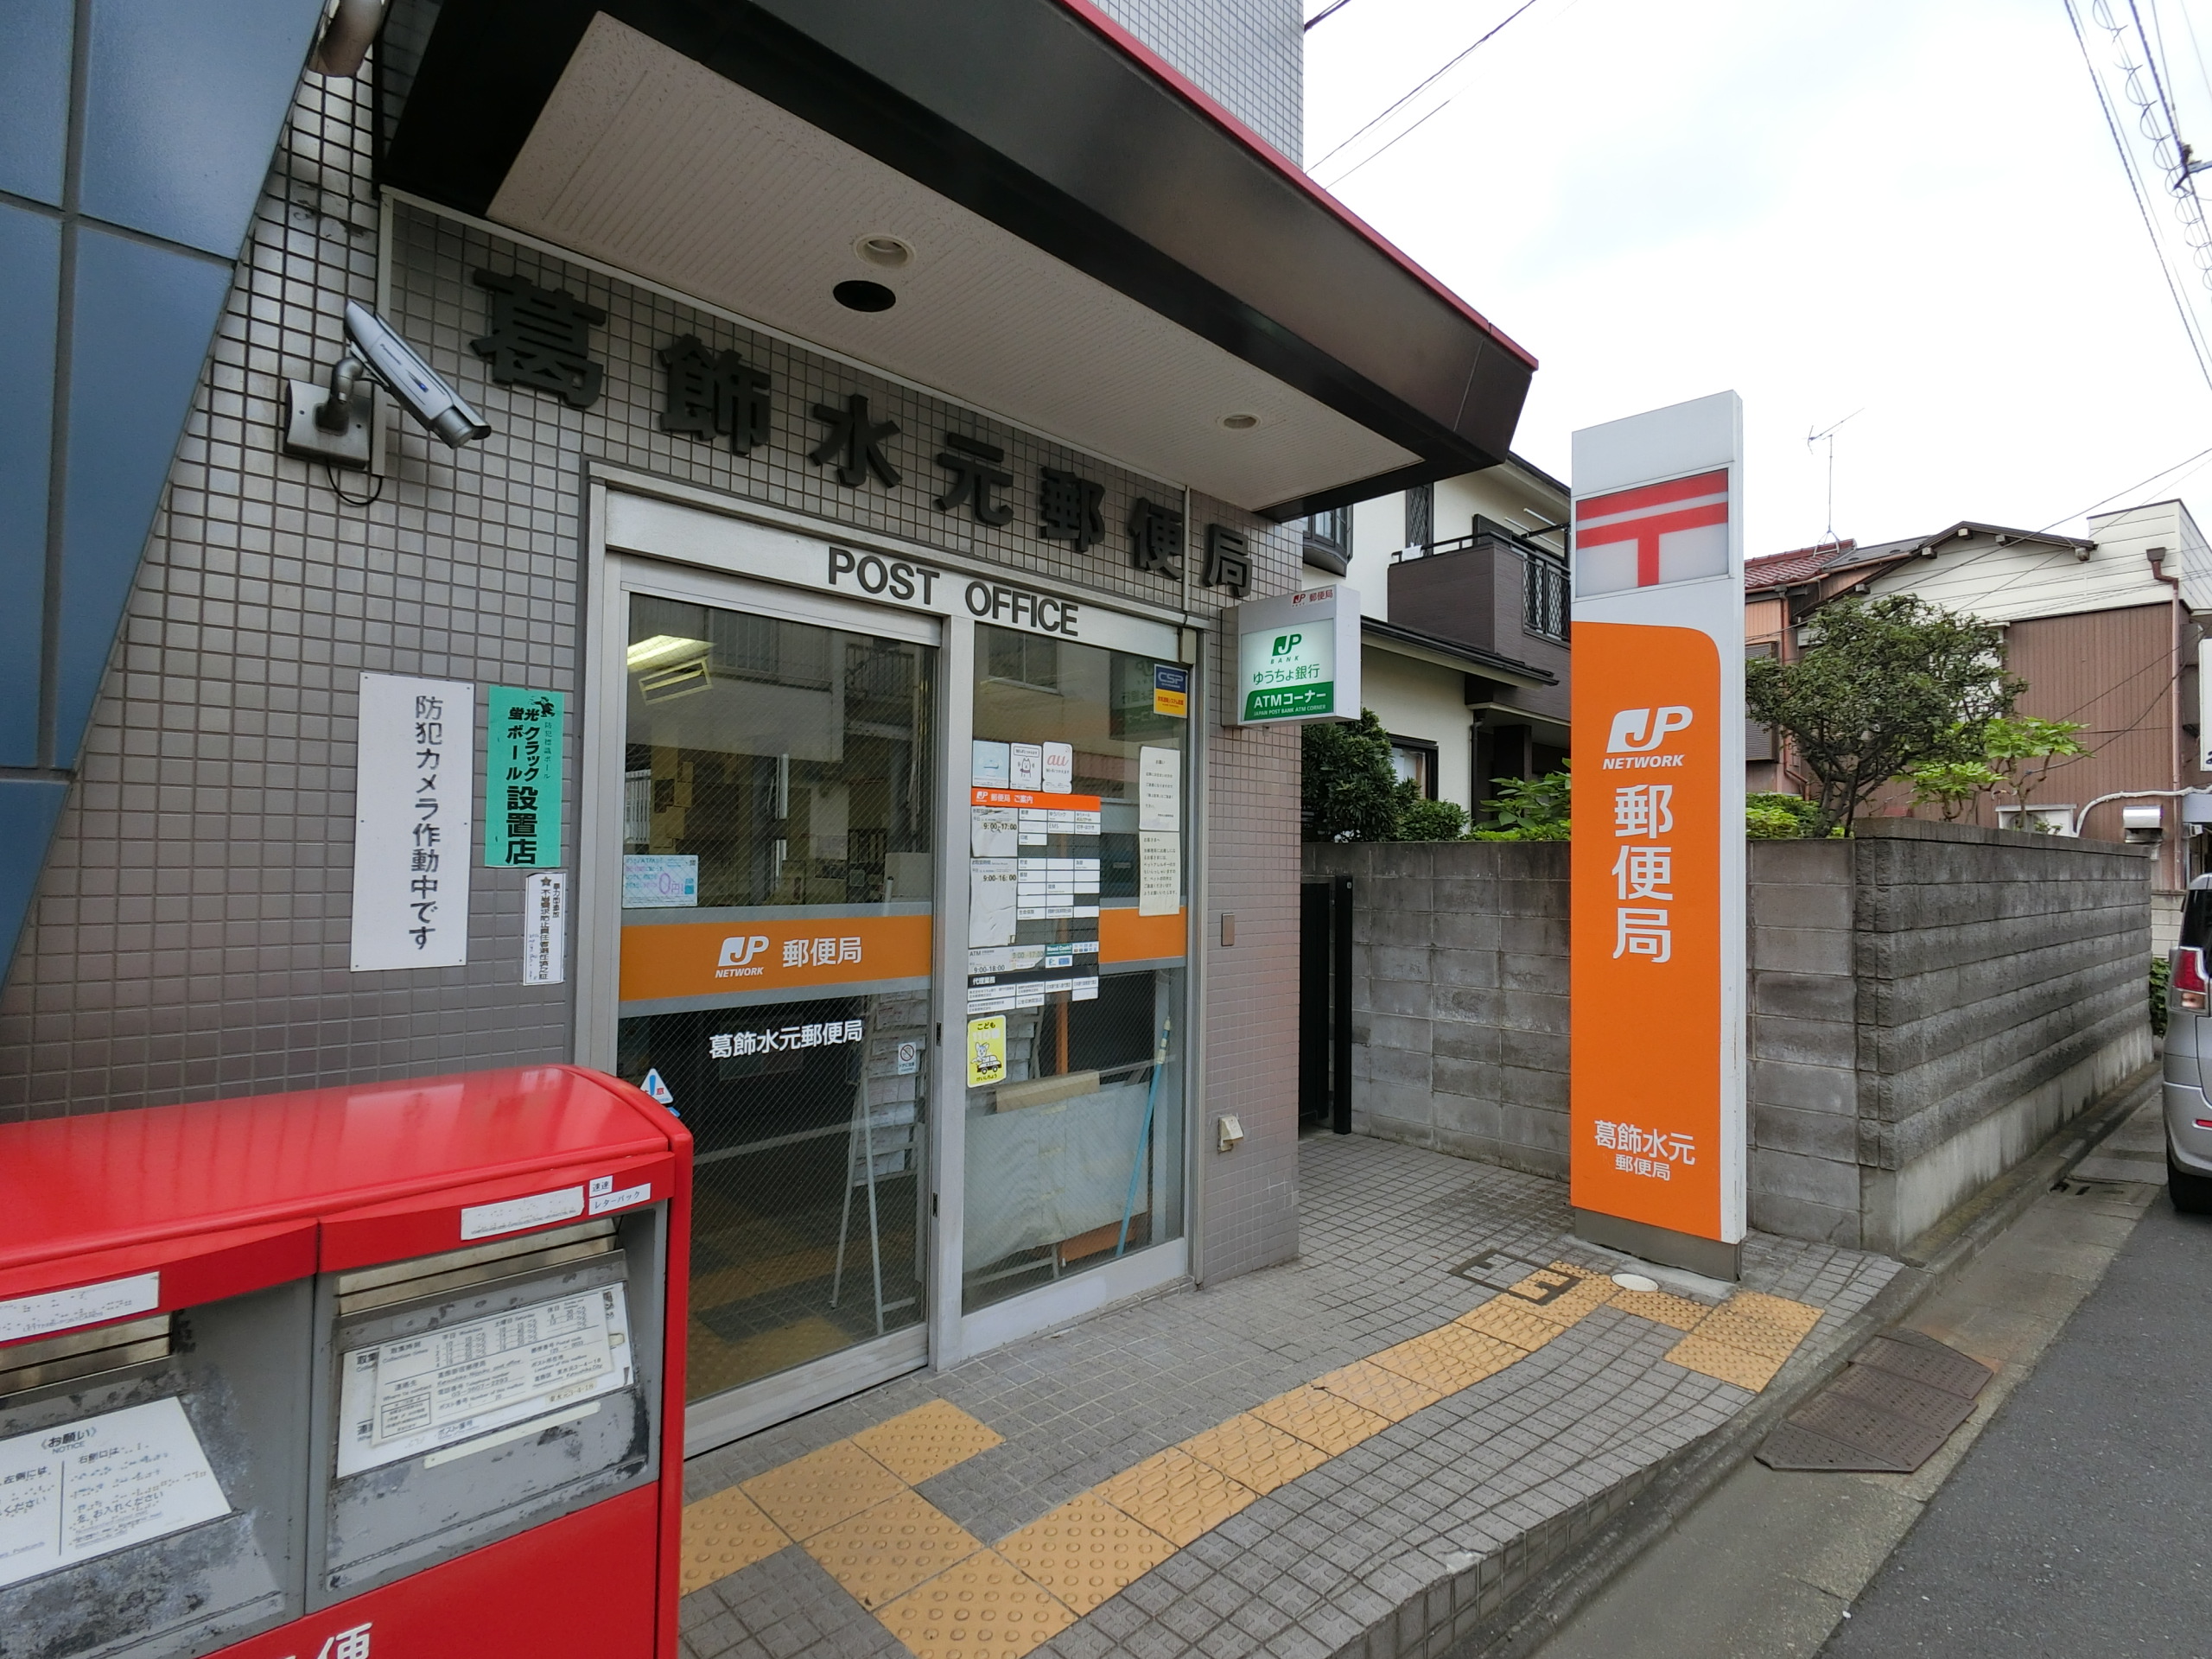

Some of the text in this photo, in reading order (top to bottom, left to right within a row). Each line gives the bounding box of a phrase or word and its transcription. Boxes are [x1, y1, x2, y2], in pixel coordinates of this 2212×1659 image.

[470, 268, 1253, 597] 葛飾水元郵便局
[828, 546, 1079, 638] POST OFFICE
[1309, 589, 1333, 602] 郵便局
[1272, 633, 1302, 657] JP
[1270, 655, 1300, 664] BANK
[1158, 671, 1184, 684] CSP
[1253, 664, 1320, 686] ゆうちょ銀行
[1254, 690, 1326, 709] ATMコーナー
[508, 707, 540, 722] 蛍光
[1606, 705, 1694, 753] JP
[506, 725, 524, 781] ボール
[524, 726, 539, 782] クラック
[1047, 754, 1070, 766] au
[1602, 754, 1685, 770] NETWORK
[990, 793, 1010, 803] 郵便局
[1014, 795, 1033, 804] ご案内
[409, 696, 443, 950] 防犯カメラ作動中です
[505, 785, 538, 865] 設置店
[1611, 784, 1674, 963] 郵便局
[717, 936, 769, 967] JP
[782, 937, 861, 968] 郵便局
[715, 967, 764, 978] NETWORK
[974, 964, 1005, 973] 9:00-18:00
[977, 1021, 995, 1030] こども
[709, 1019, 863, 1060] 葛飾水元郵便局
[1594, 1120, 1695, 1166] 葛飾水元
[1615, 1154, 1670, 1181] 郵便局
[592, 1180, 609, 1192] 速達
[594, 1191, 640, 1210] レターパック
[53, 1441, 86, 1454] NOTICE
